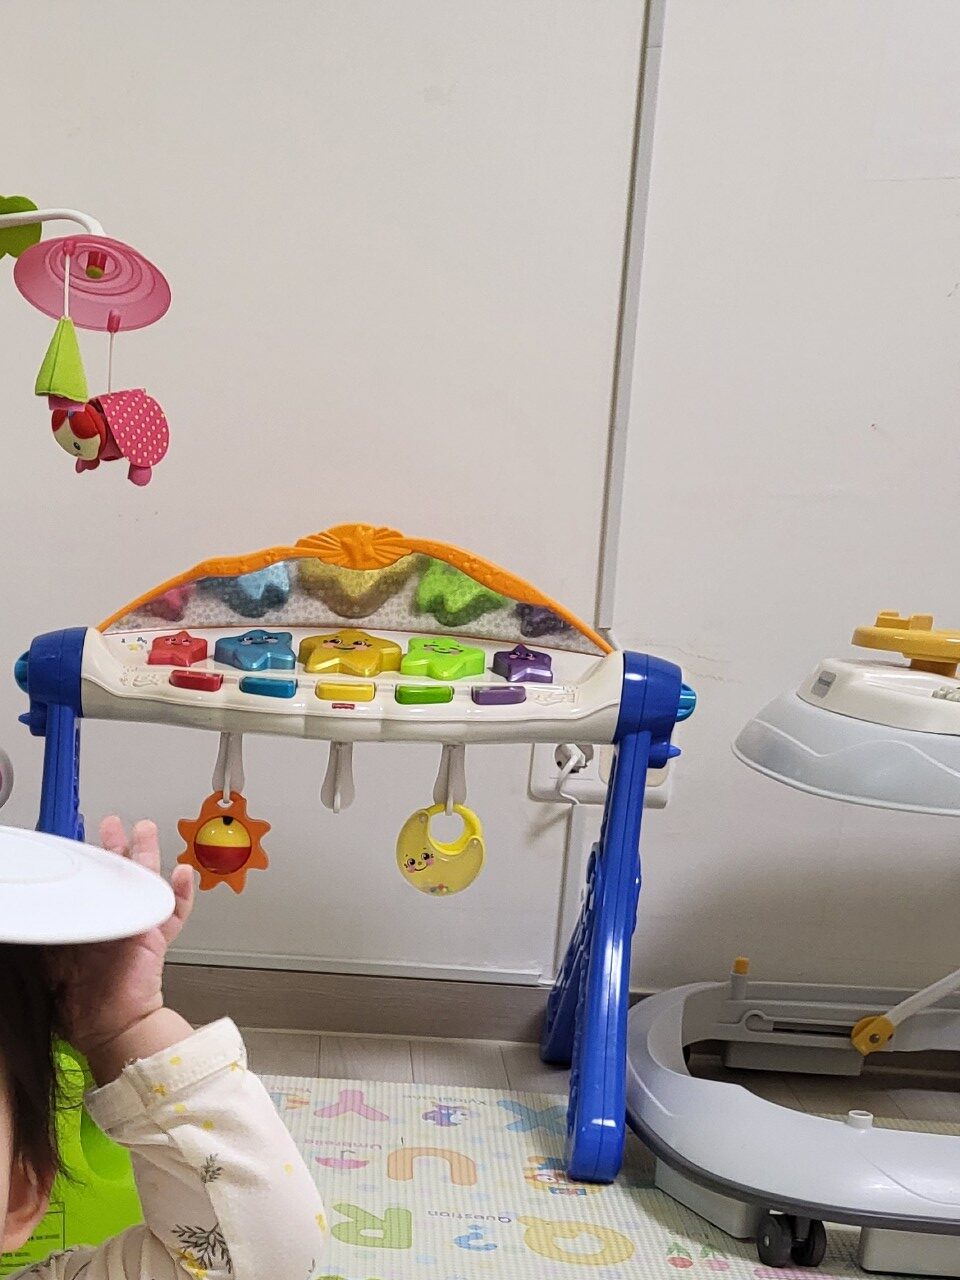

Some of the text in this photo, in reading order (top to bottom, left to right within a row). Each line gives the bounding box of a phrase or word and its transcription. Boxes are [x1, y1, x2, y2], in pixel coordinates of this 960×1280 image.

[387, 1147, 477, 1186] U
[331, 1202, 413, 1250] R
[427, 1209, 512, 1224] Question
[517, 1214, 636, 1267] Q
